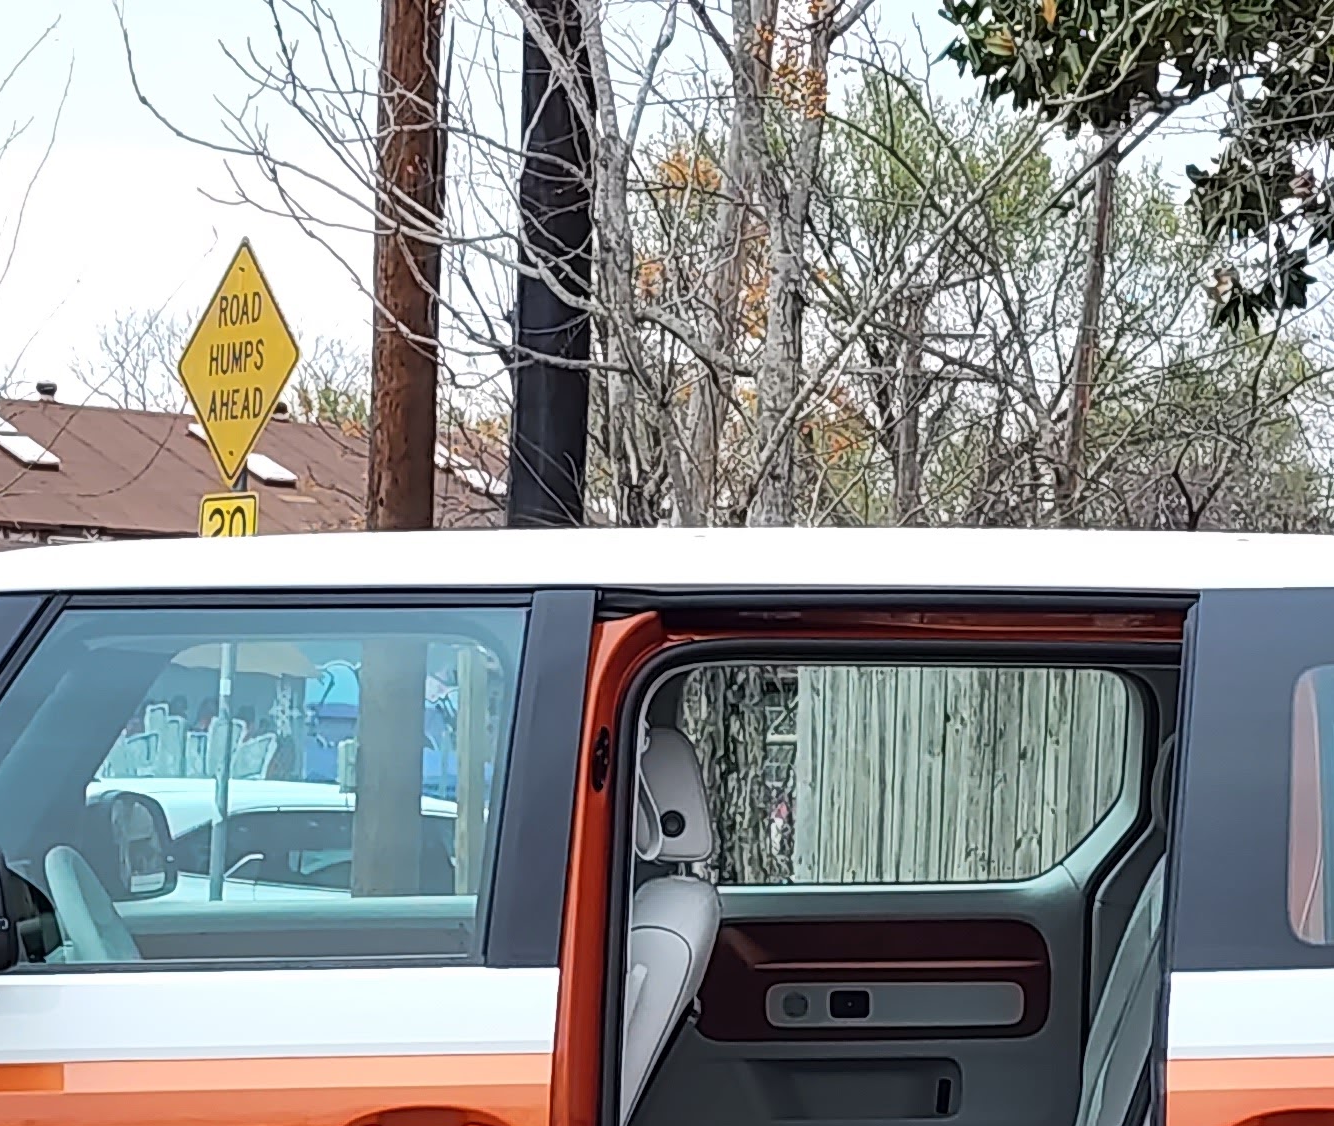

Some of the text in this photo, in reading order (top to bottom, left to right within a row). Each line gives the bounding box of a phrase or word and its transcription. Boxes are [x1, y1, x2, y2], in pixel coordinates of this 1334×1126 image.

[218, 291, 262, 328] ROAD
[209, 338, 265, 377] HUMPS
[207, 387, 263, 423] AHEAD
[208, 505, 247, 537] 20
